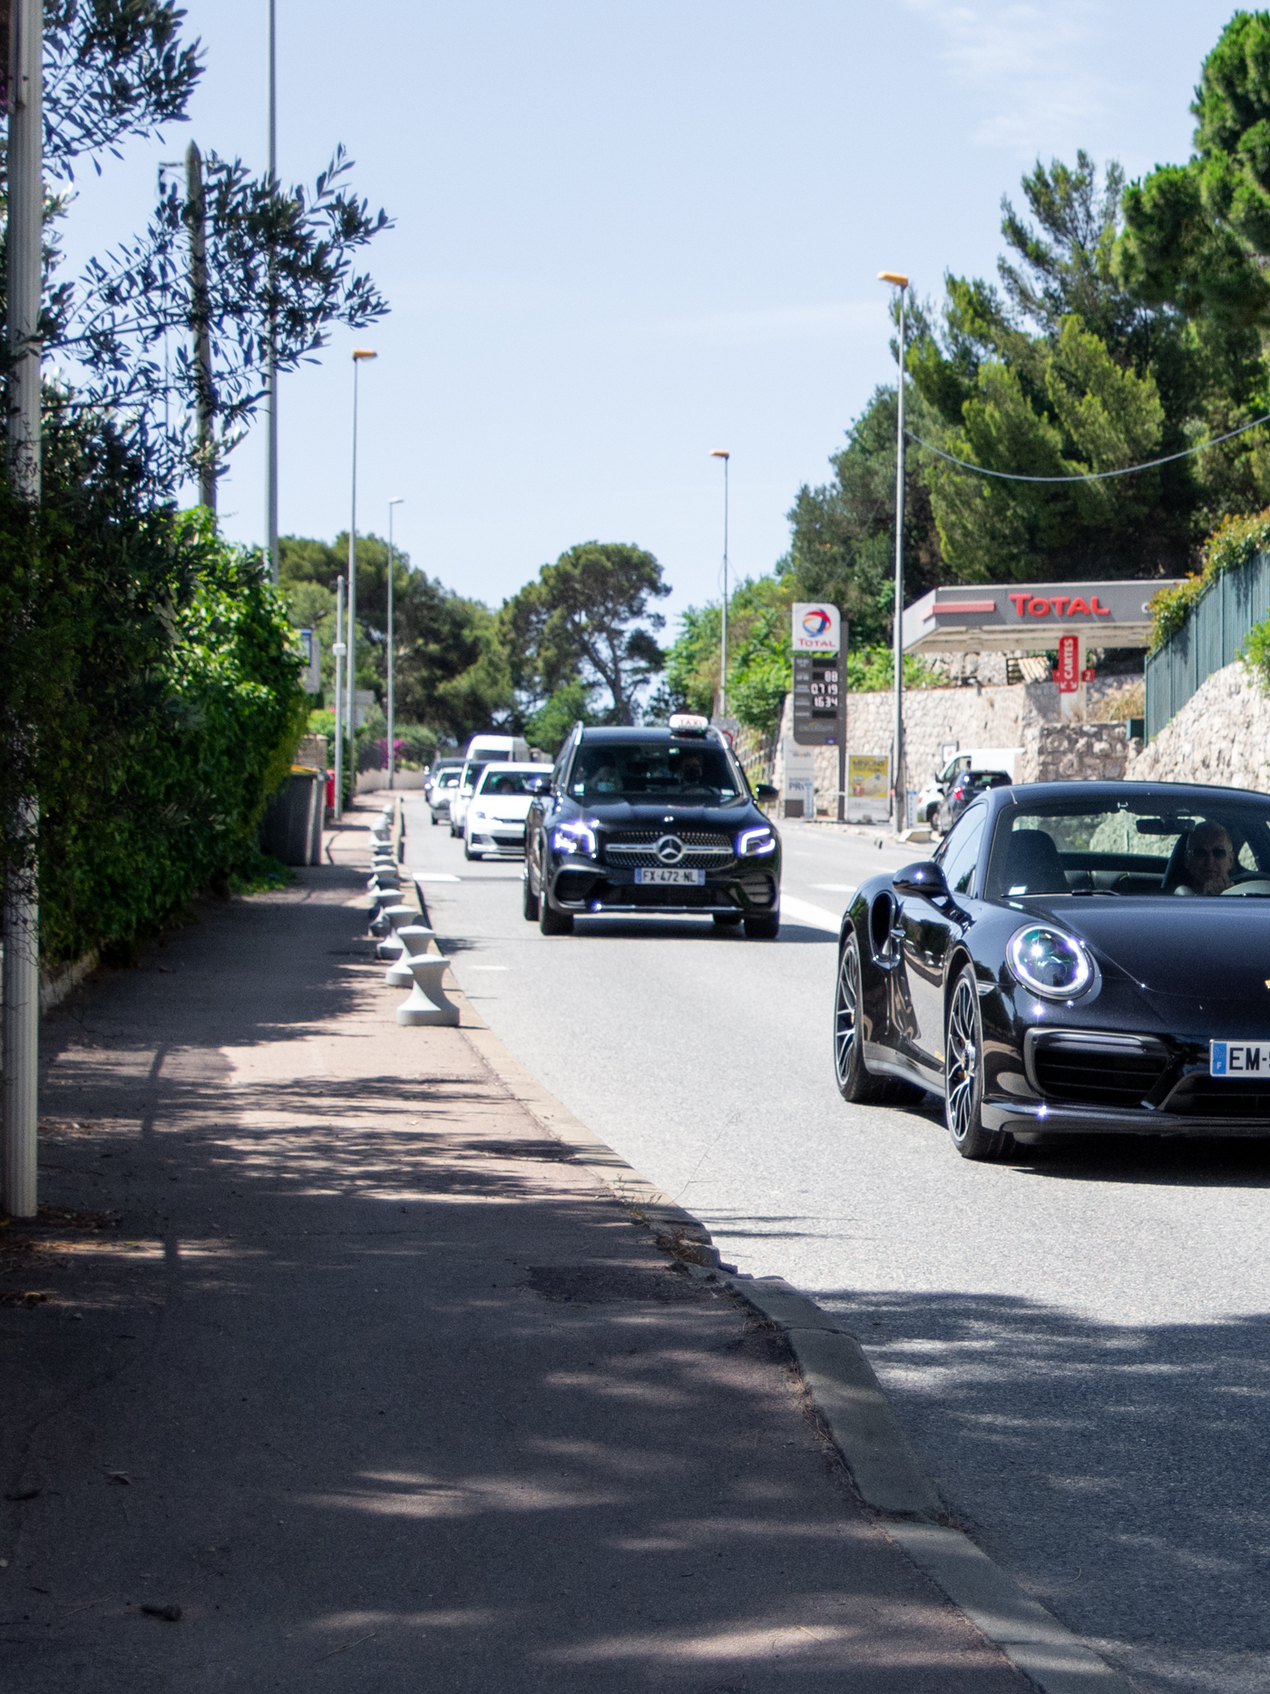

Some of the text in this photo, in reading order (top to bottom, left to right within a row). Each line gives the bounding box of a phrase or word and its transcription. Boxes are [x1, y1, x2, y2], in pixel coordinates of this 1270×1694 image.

[1009, 593, 1110, 617] TOTAL
[798, 638, 836, 648] TOTAL
[1064, 639, 1073, 679] CARTES
[1085, 671, 1091, 680] 2
[643, 870, 697, 884] FX-472-NL
[1216, 1062, 1222, 1070] F
